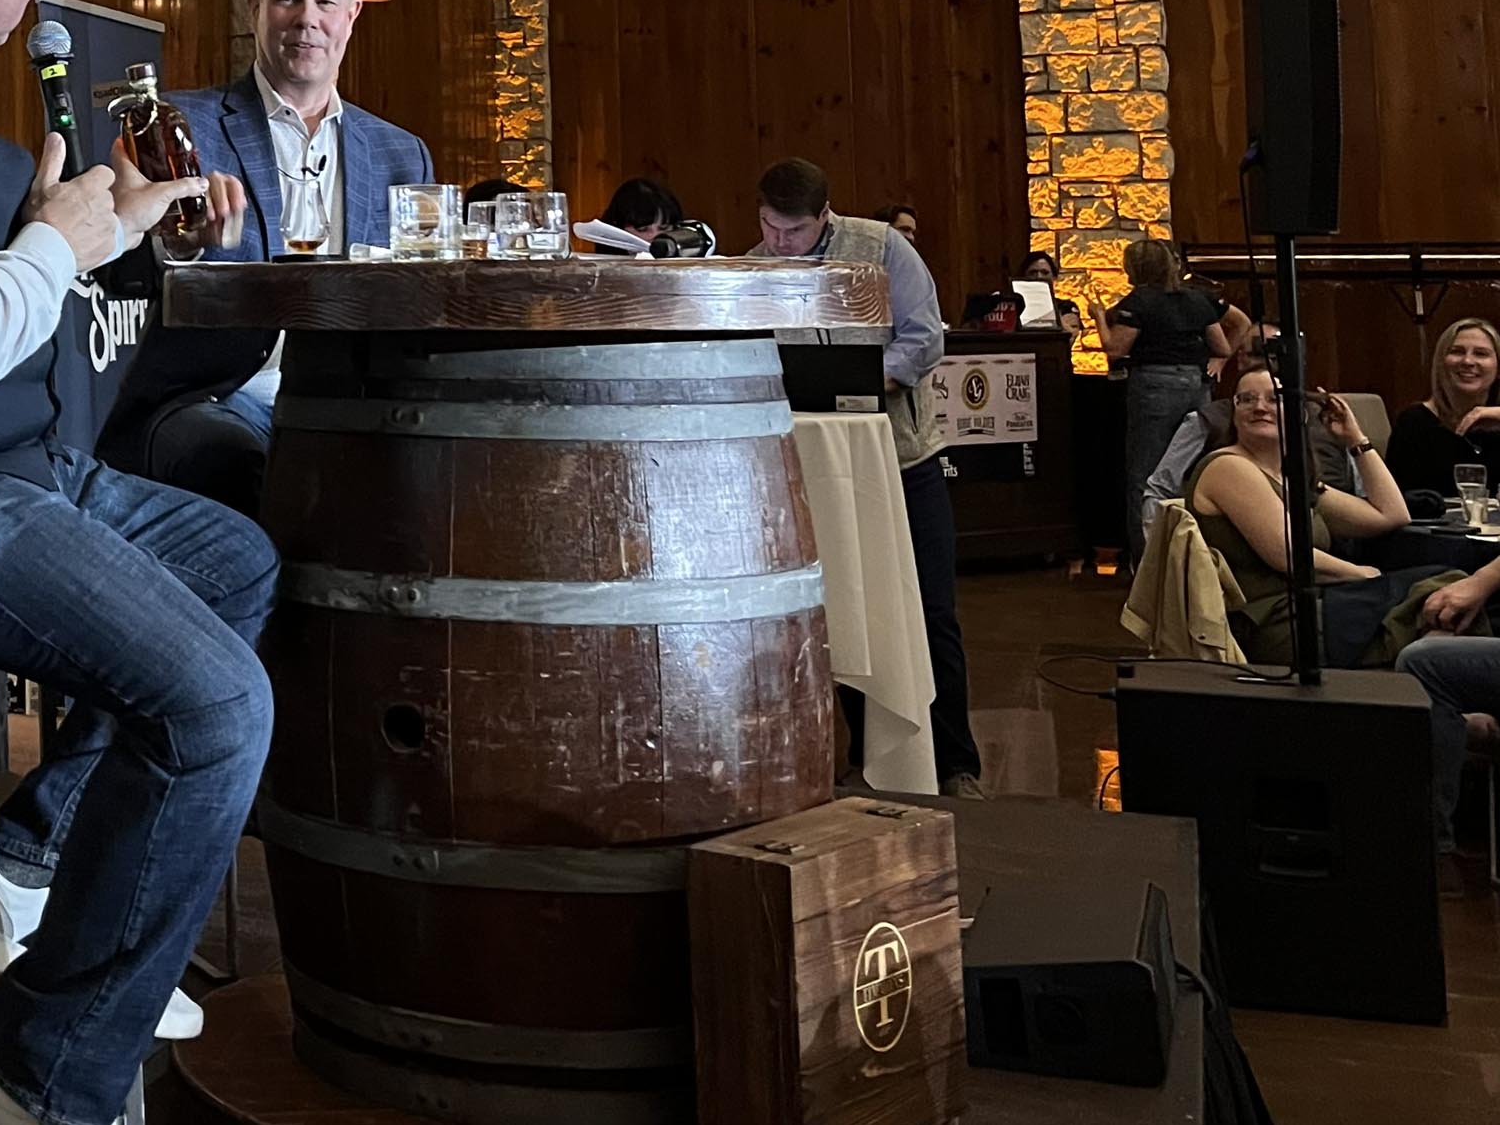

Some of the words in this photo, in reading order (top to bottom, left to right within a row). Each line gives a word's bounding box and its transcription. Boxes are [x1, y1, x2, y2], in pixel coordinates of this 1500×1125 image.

[50, 67, 57, 76] 2
[89, 282, 148, 372] Spiri
[1006, 386, 1031, 402] CRAIG
